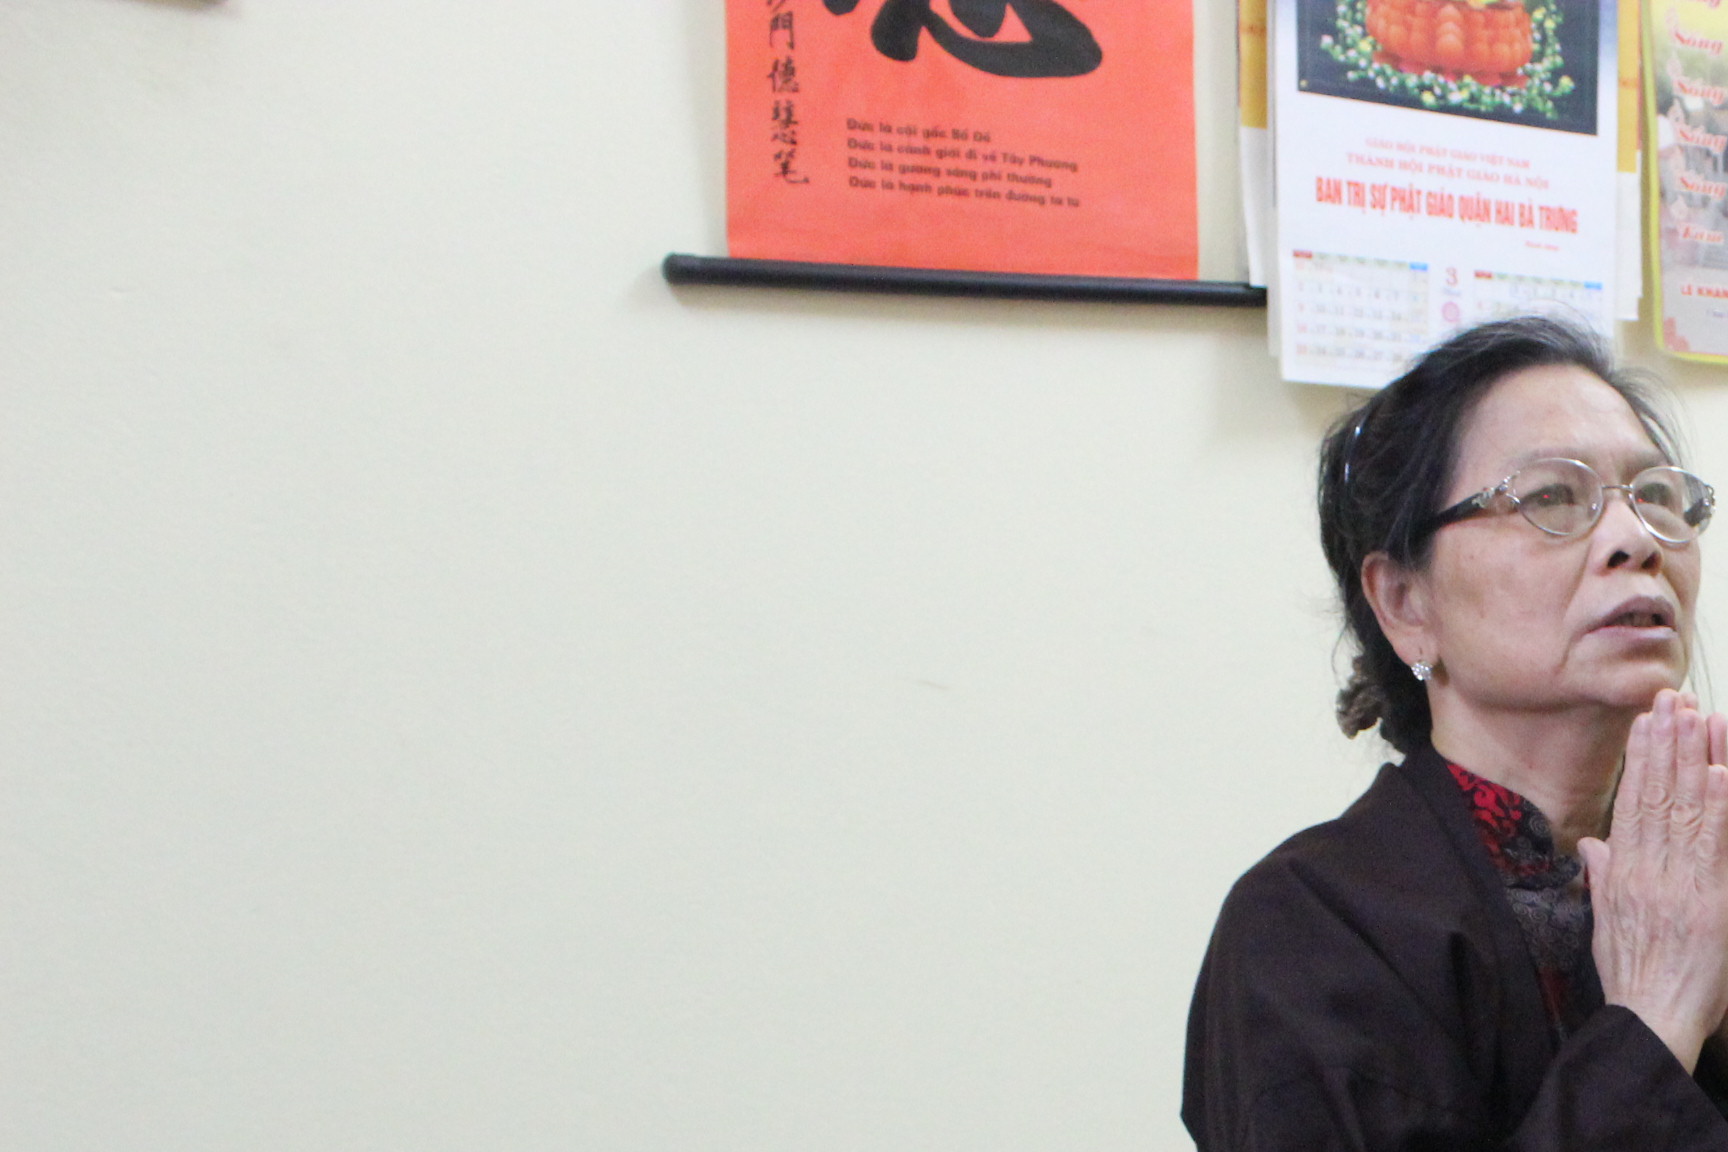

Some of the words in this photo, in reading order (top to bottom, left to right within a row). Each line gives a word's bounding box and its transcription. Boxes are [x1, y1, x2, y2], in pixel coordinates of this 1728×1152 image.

[1315, 176, 1343, 206] BAN
[1346, 180, 1366, 215] TRỊ
[1369, 182, 1389, 217] SỰ
[1390, 182, 1422, 220] PHẬT
[1426, 186, 1455, 219] GIÁO
[1458, 191, 1492, 228] QUẬN
[1495, 199, 1516, 227] HAI
[1518, 197, 1536, 230] BÀ
[1538, 204, 1579, 235] TRƯNG
[1446, 266, 1458, 286] 3
